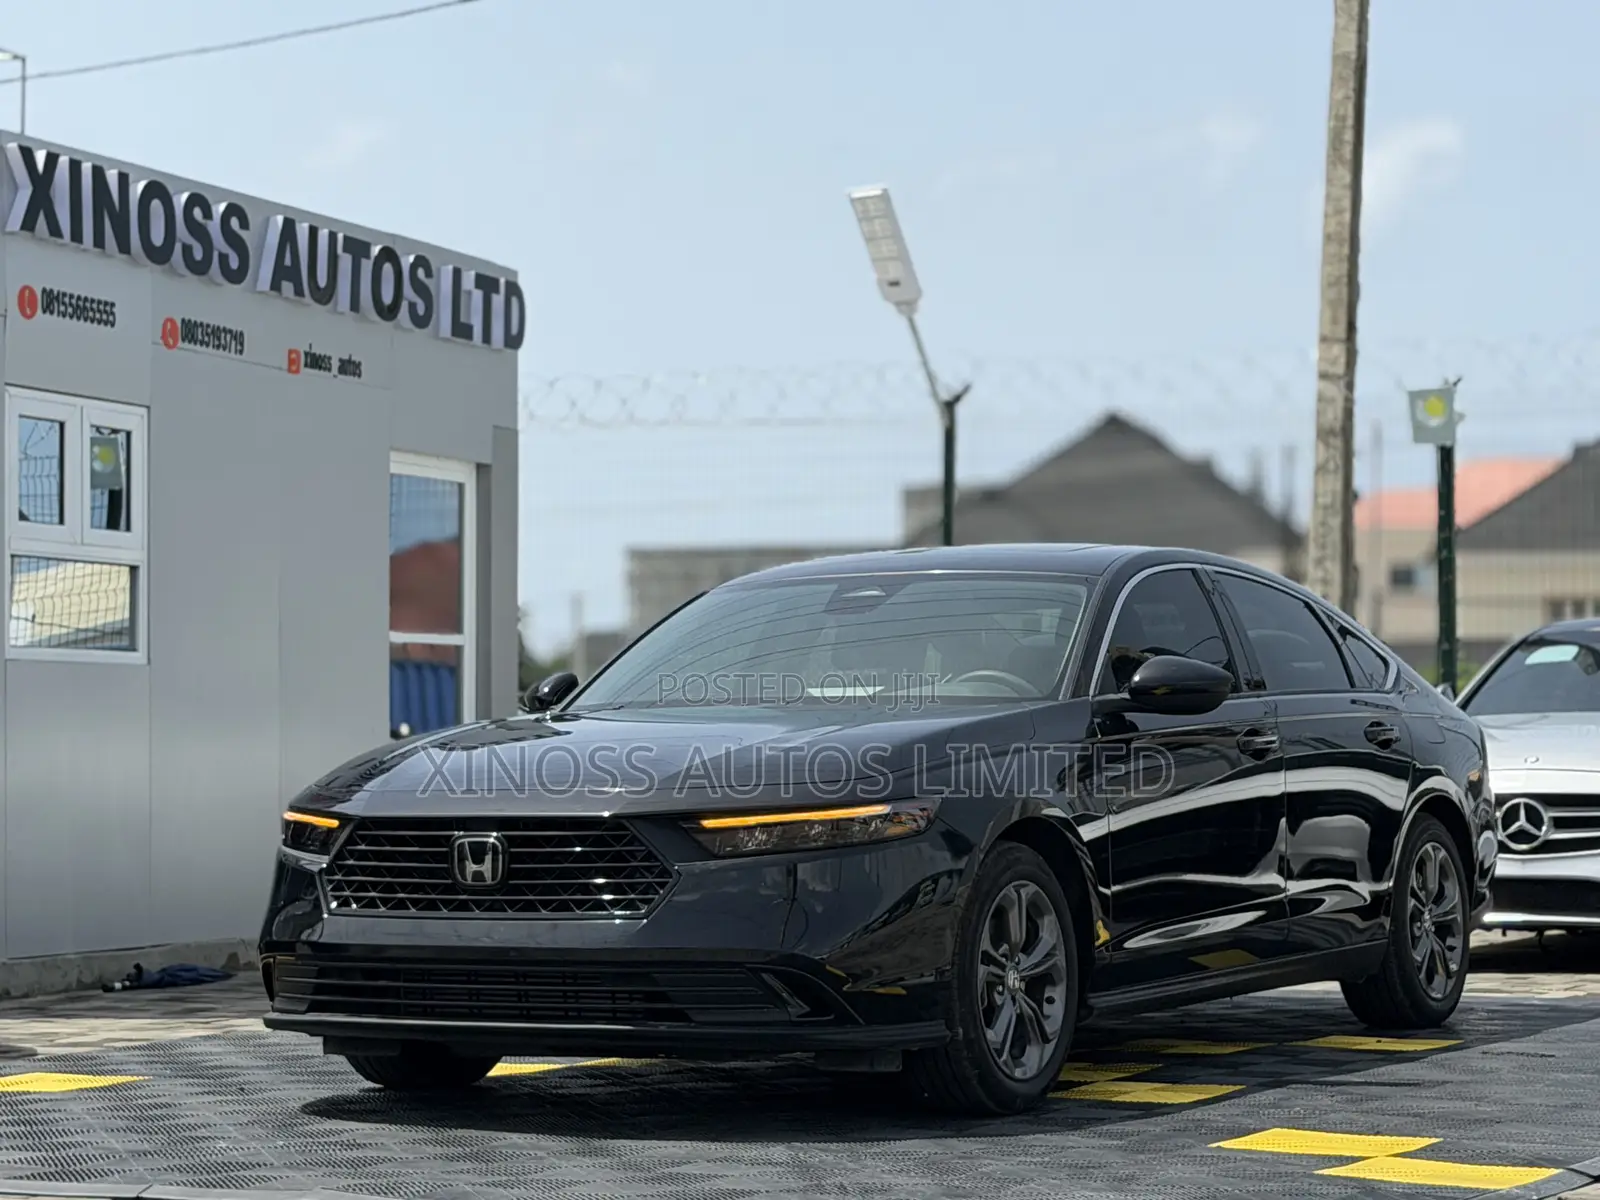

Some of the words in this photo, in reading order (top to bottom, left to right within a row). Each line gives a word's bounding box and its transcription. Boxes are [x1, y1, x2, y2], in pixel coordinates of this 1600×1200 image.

[5, 142, 250, 285] XINOSS
[256, 214, 434, 330] AUTOS
[438, 264, 526, 351] LTD
